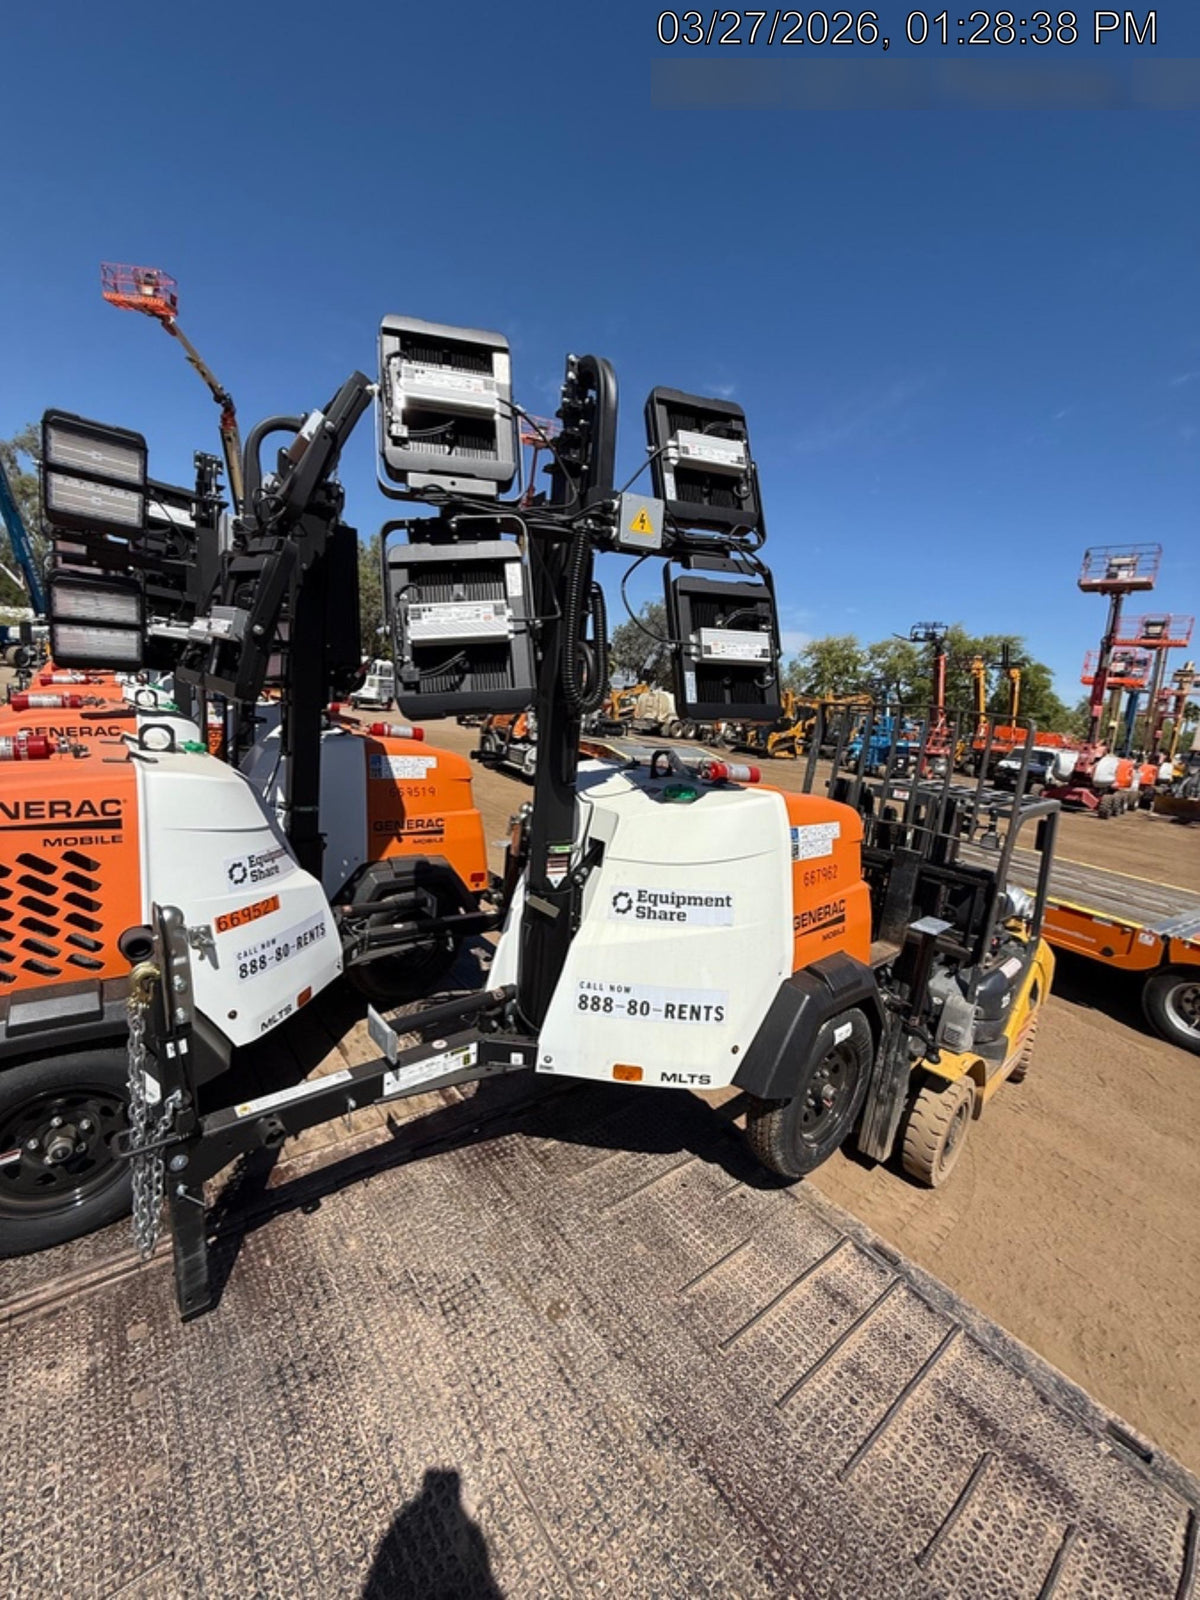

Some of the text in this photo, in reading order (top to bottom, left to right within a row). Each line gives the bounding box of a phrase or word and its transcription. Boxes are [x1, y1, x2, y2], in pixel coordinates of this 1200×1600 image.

[373, 818, 445, 831] GENERAC
[43, 835, 123, 847] MOBILE
[250, 865, 280, 883] Share
[803, 864, 838, 887] 667962
[637, 889, 732, 908] Equipment
[216, 895, 280, 932] 669521
[635, 906, 687, 922] Share
[793, 899, 846, 931] GENERAC
[236, 938, 276, 961] CALL NOW
[238, 922, 326, 979] 888-80-RENTS
[579, 980, 632, 994] CALL NOW
[577, 993, 725, 1022] 888-80-RENTS
[660, 1071, 711, 1085] MLTS
